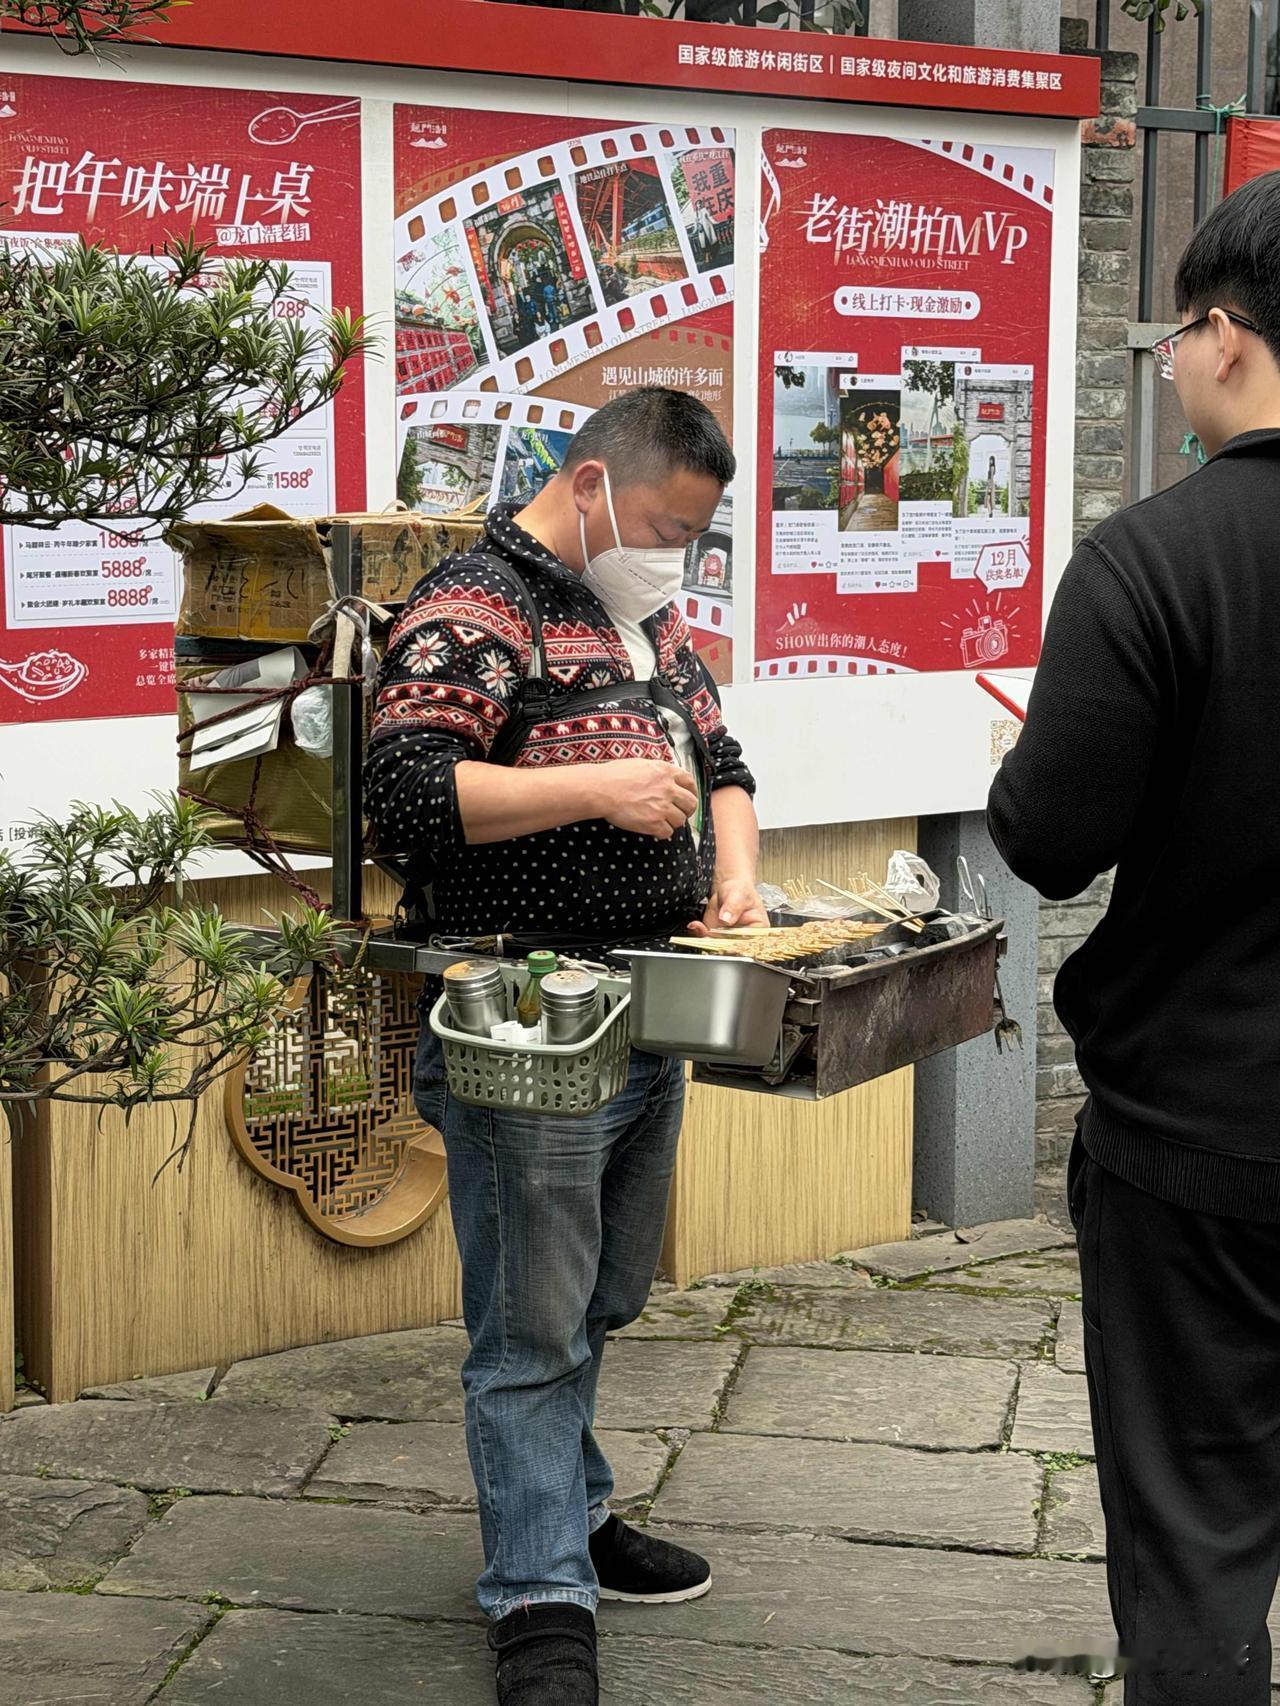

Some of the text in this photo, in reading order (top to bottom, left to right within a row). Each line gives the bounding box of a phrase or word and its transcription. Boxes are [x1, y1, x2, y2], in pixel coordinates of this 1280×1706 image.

[678, 44, 1062, 91] 国家级旅游休闲街区 国家级夜间文化和旅游消费集聚区
[7, 150, 316, 226] 把年味端上桌
[219, 223, 309, 245] @龙门浩老街
[794, 192, 1028, 264] 老街潮拍MVP
[852, 292, 963, 314] 线上打卡·现金激励
[601, 366, 723, 386] 遇见山城的许多面
[273, 472, 309, 489] 1588
[991, 549, 1016, 567] 12月
[101, 560, 142, 578] 5888
[108, 589, 149, 607] 8888
